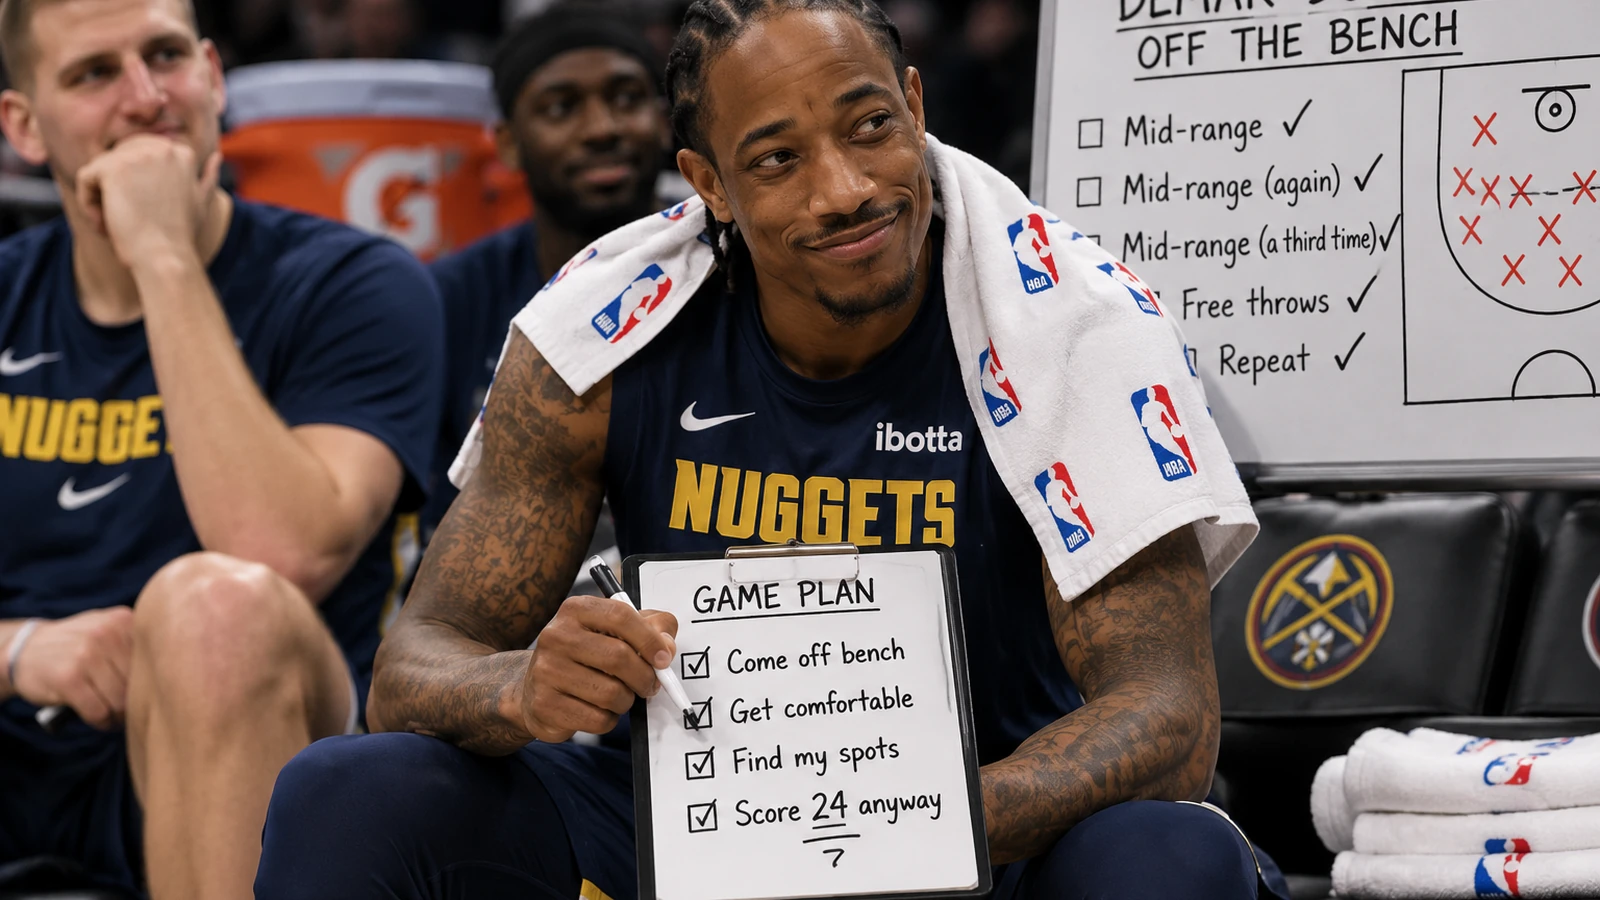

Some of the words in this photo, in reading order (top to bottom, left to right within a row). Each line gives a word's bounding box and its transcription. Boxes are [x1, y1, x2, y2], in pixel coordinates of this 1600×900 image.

[1138, 31, 1206, 69] OFF
[1231, 23, 1302, 61] THE
[1329, 9, 1458, 55] BENCH
[1124, 113, 1263, 153] Mid-range
[1123, 172, 1253, 211] Mid-range
[1265, 162, 1340, 207] (again)
[1122, 230, 1250, 269] Mid-range
[1259, 224, 1279, 259] (a
[1282, 224, 1326, 253] third
[1330, 221, 1377, 256] time)
[1182, 287, 1234, 320] Free
[1246, 286, 1330, 316] throws
[1219, 343, 1311, 386] Repeat
[0, 393, 174, 465] NUGGE
[875, 422, 963, 453] ibotta
[668, 459, 956, 547] NUGGETS
[693, 582, 781, 614] GAME
[796, 577, 875, 608] PLAN
[727, 648, 789, 675] Come
[798, 641, 832, 668] off
[841, 637, 905, 665] bench
[730, 697, 774, 724] Get
[784, 685, 914, 718] comfortable
[732, 744, 783, 774] Find
[794, 750, 827, 777] my
[839, 736, 900, 773] spots
[735, 799, 802, 827] Score
[811, 790, 848, 822] 24
[858, 793, 941, 825] anyway
